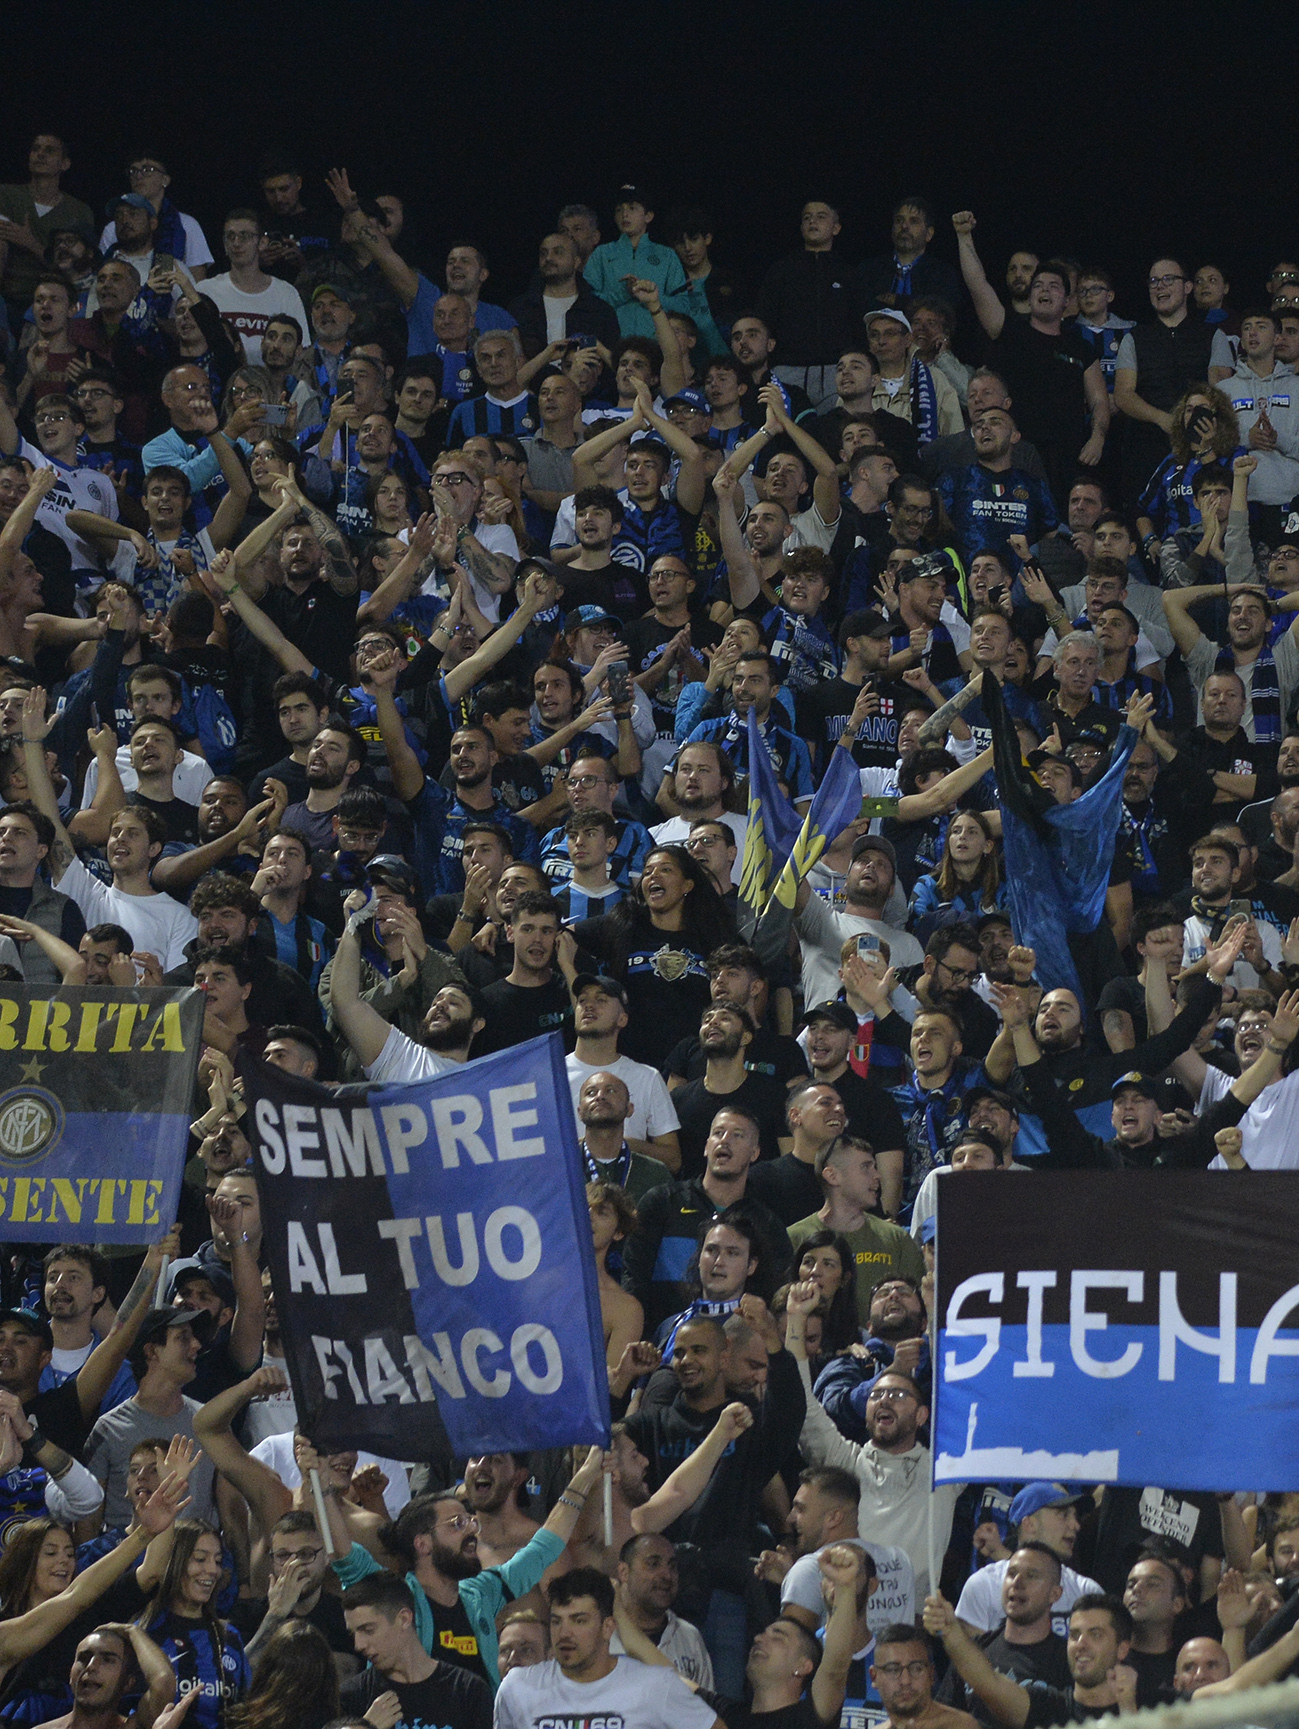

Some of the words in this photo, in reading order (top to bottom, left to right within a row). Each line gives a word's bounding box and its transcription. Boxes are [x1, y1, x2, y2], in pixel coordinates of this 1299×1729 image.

[254, 1081, 546, 1178] SEMPRE
[287, 1220, 368, 1296] AL
[376, 1204, 543, 1290] TUO
[310, 1322, 564, 1406] FIANCO
